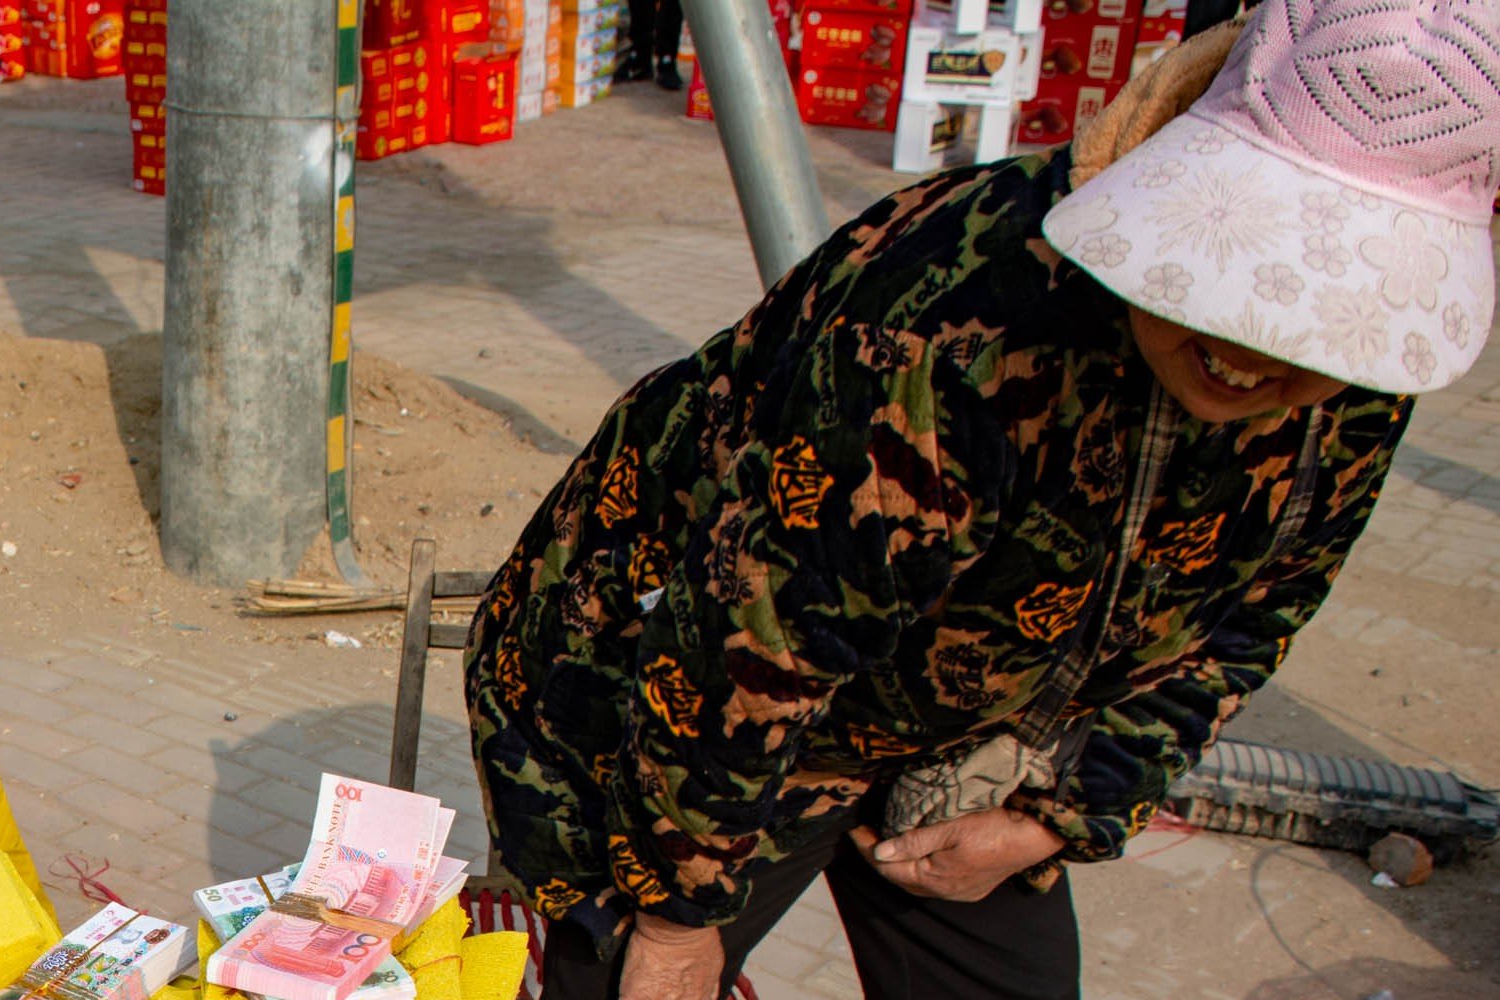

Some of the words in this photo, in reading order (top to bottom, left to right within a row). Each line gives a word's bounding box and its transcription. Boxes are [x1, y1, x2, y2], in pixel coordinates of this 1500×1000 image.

[334, 784, 364, 803] 100
[328, 801, 344, 839] NOTE
[320, 839, 338, 876] BANK
[336, 932, 384, 965] 100
